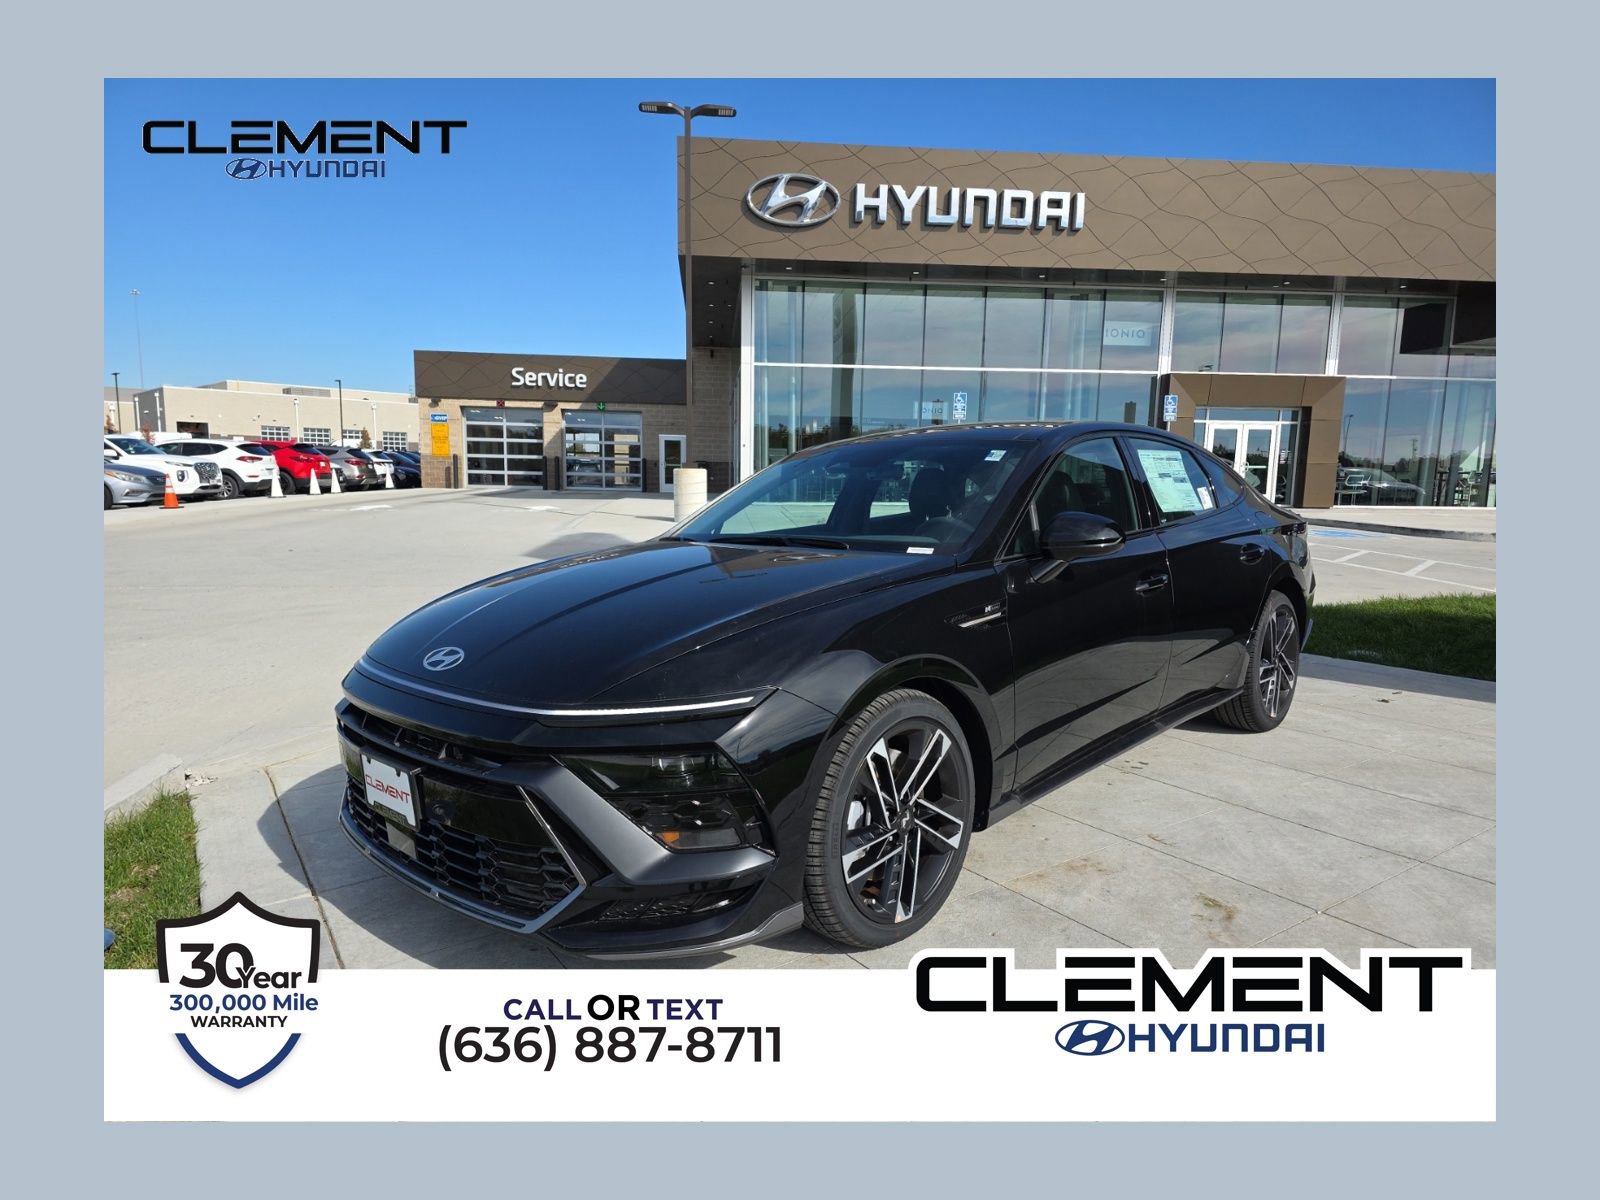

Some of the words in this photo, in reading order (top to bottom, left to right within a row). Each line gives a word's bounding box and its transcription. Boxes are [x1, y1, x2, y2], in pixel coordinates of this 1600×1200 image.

[854, 183, 1087, 232] HYUNDAI
[511, 367, 588, 388] Service
[365, 773, 410, 803] CLEMENT
